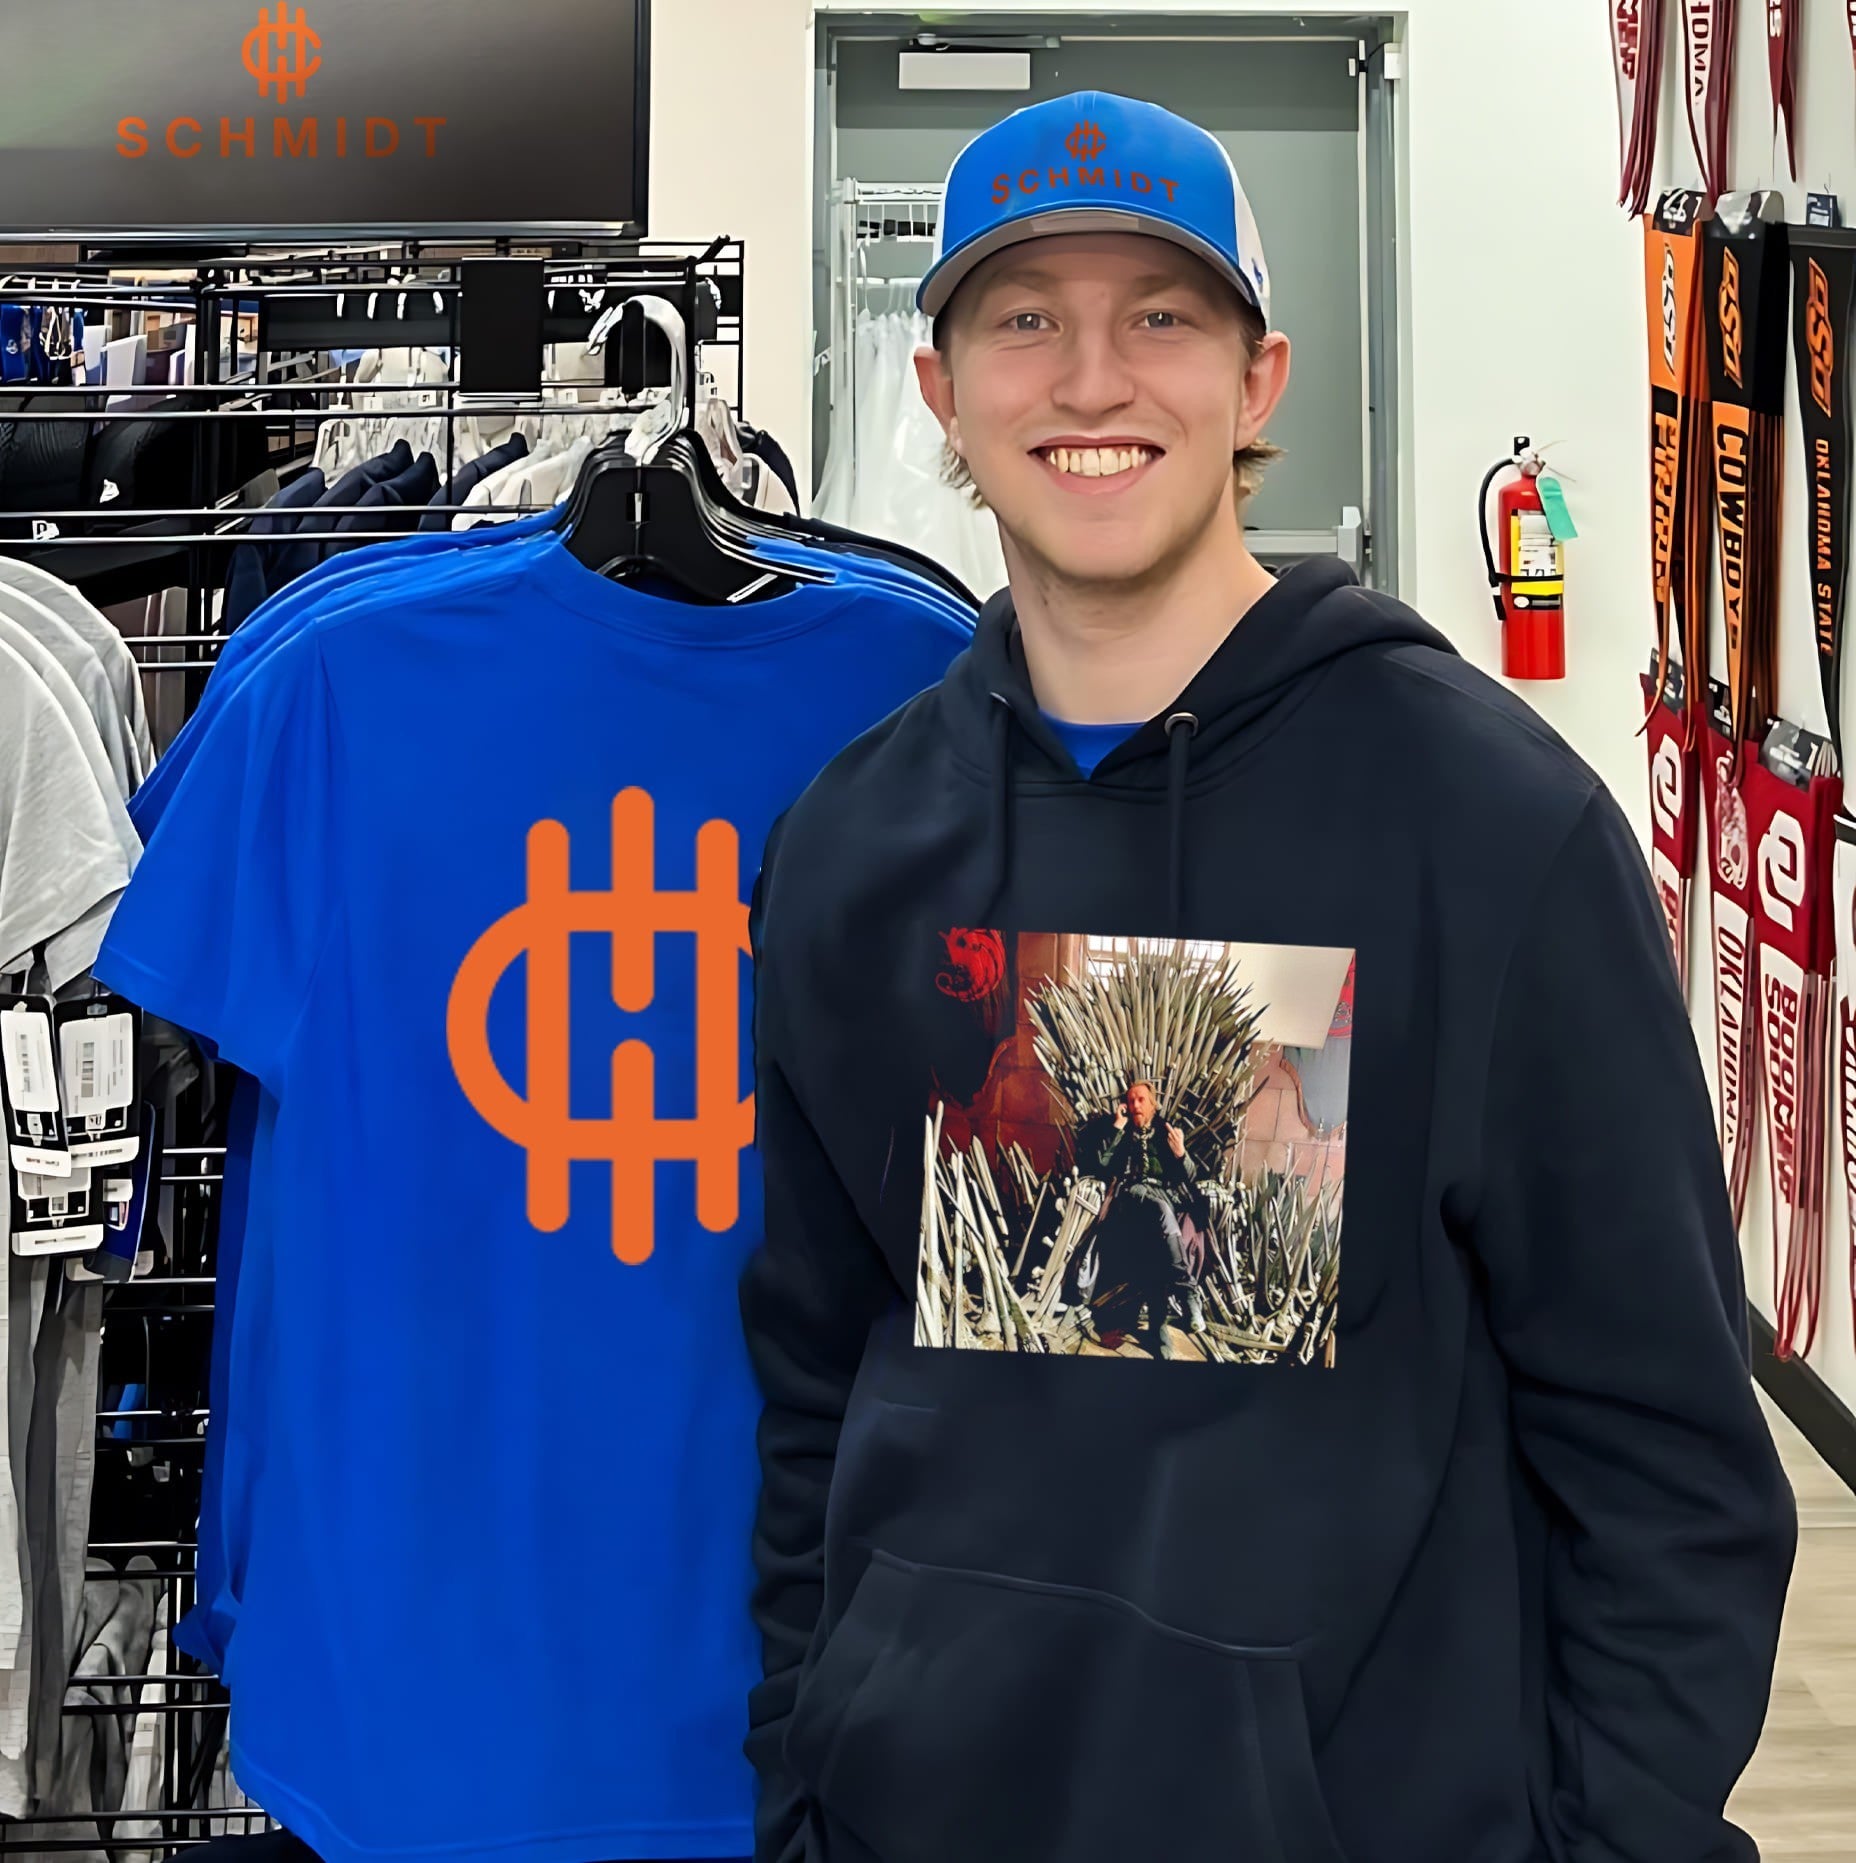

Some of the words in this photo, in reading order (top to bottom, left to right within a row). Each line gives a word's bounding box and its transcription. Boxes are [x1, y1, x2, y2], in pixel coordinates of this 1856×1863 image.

[115, 116, 448, 159] SCHMIDT
[991, 167, 1180, 204] SCHMIDT
[1815, 438, 1832, 570] OKLAHOMA
[1717, 926, 1745, 1145] OKLAHOMA
